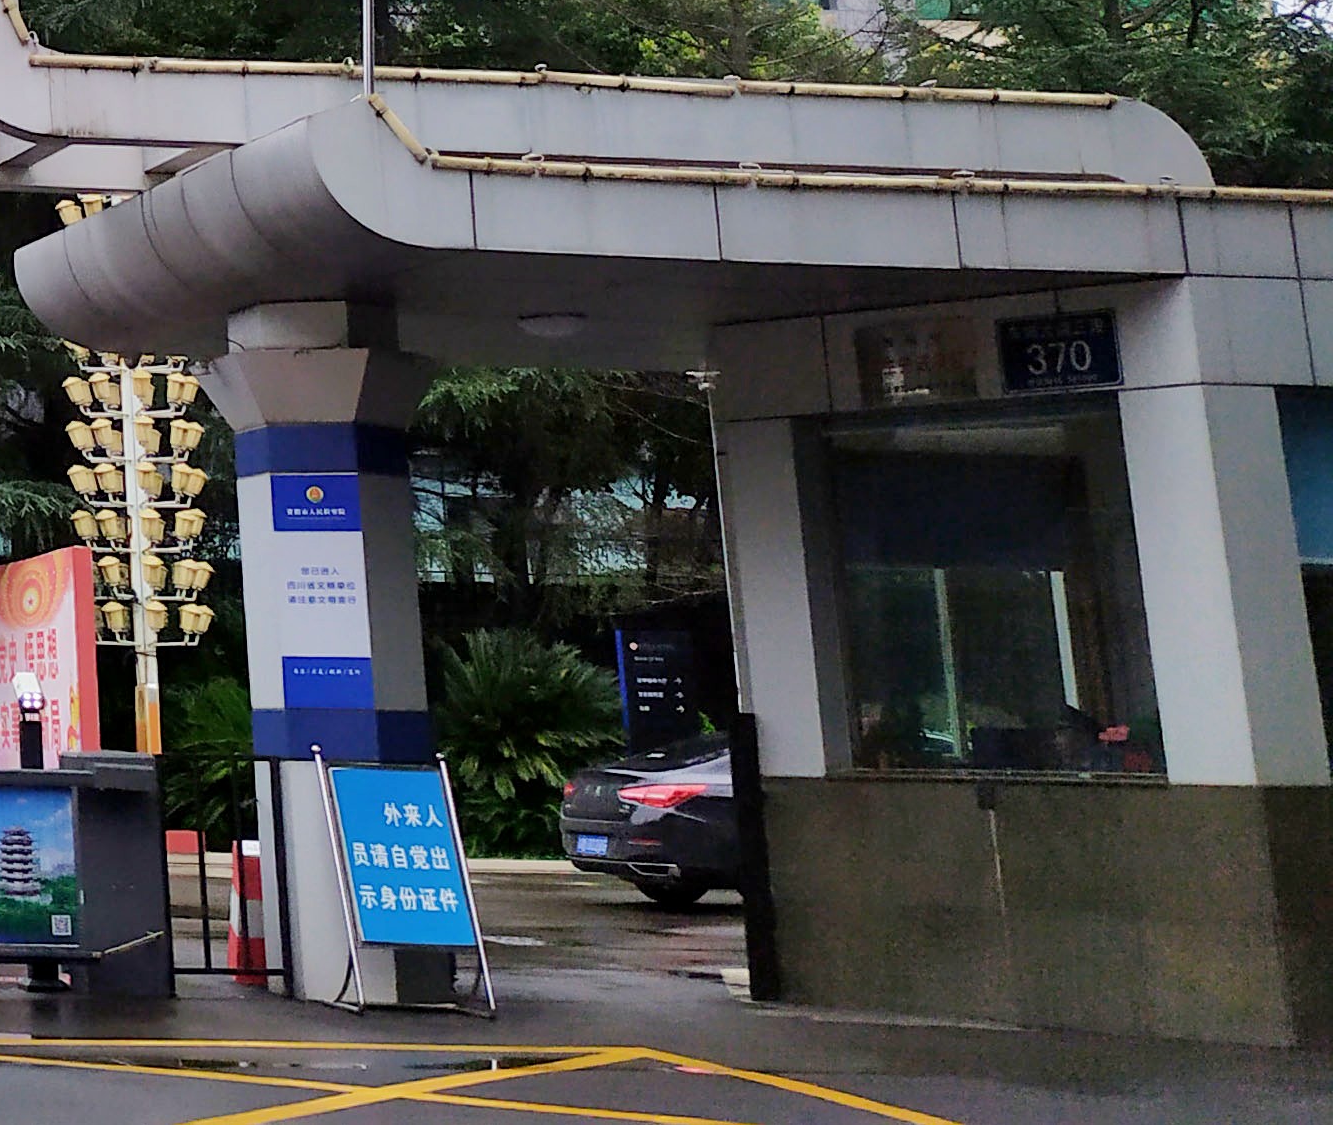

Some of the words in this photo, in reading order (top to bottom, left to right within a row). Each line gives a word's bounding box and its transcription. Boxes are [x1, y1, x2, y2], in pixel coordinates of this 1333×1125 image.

[1027, 339, 1092, 375] 370
[383, 802, 444, 827] 外来人
[352, 842, 451, 870] 员请自觉出
[358, 884, 459, 913] 示身份证件
